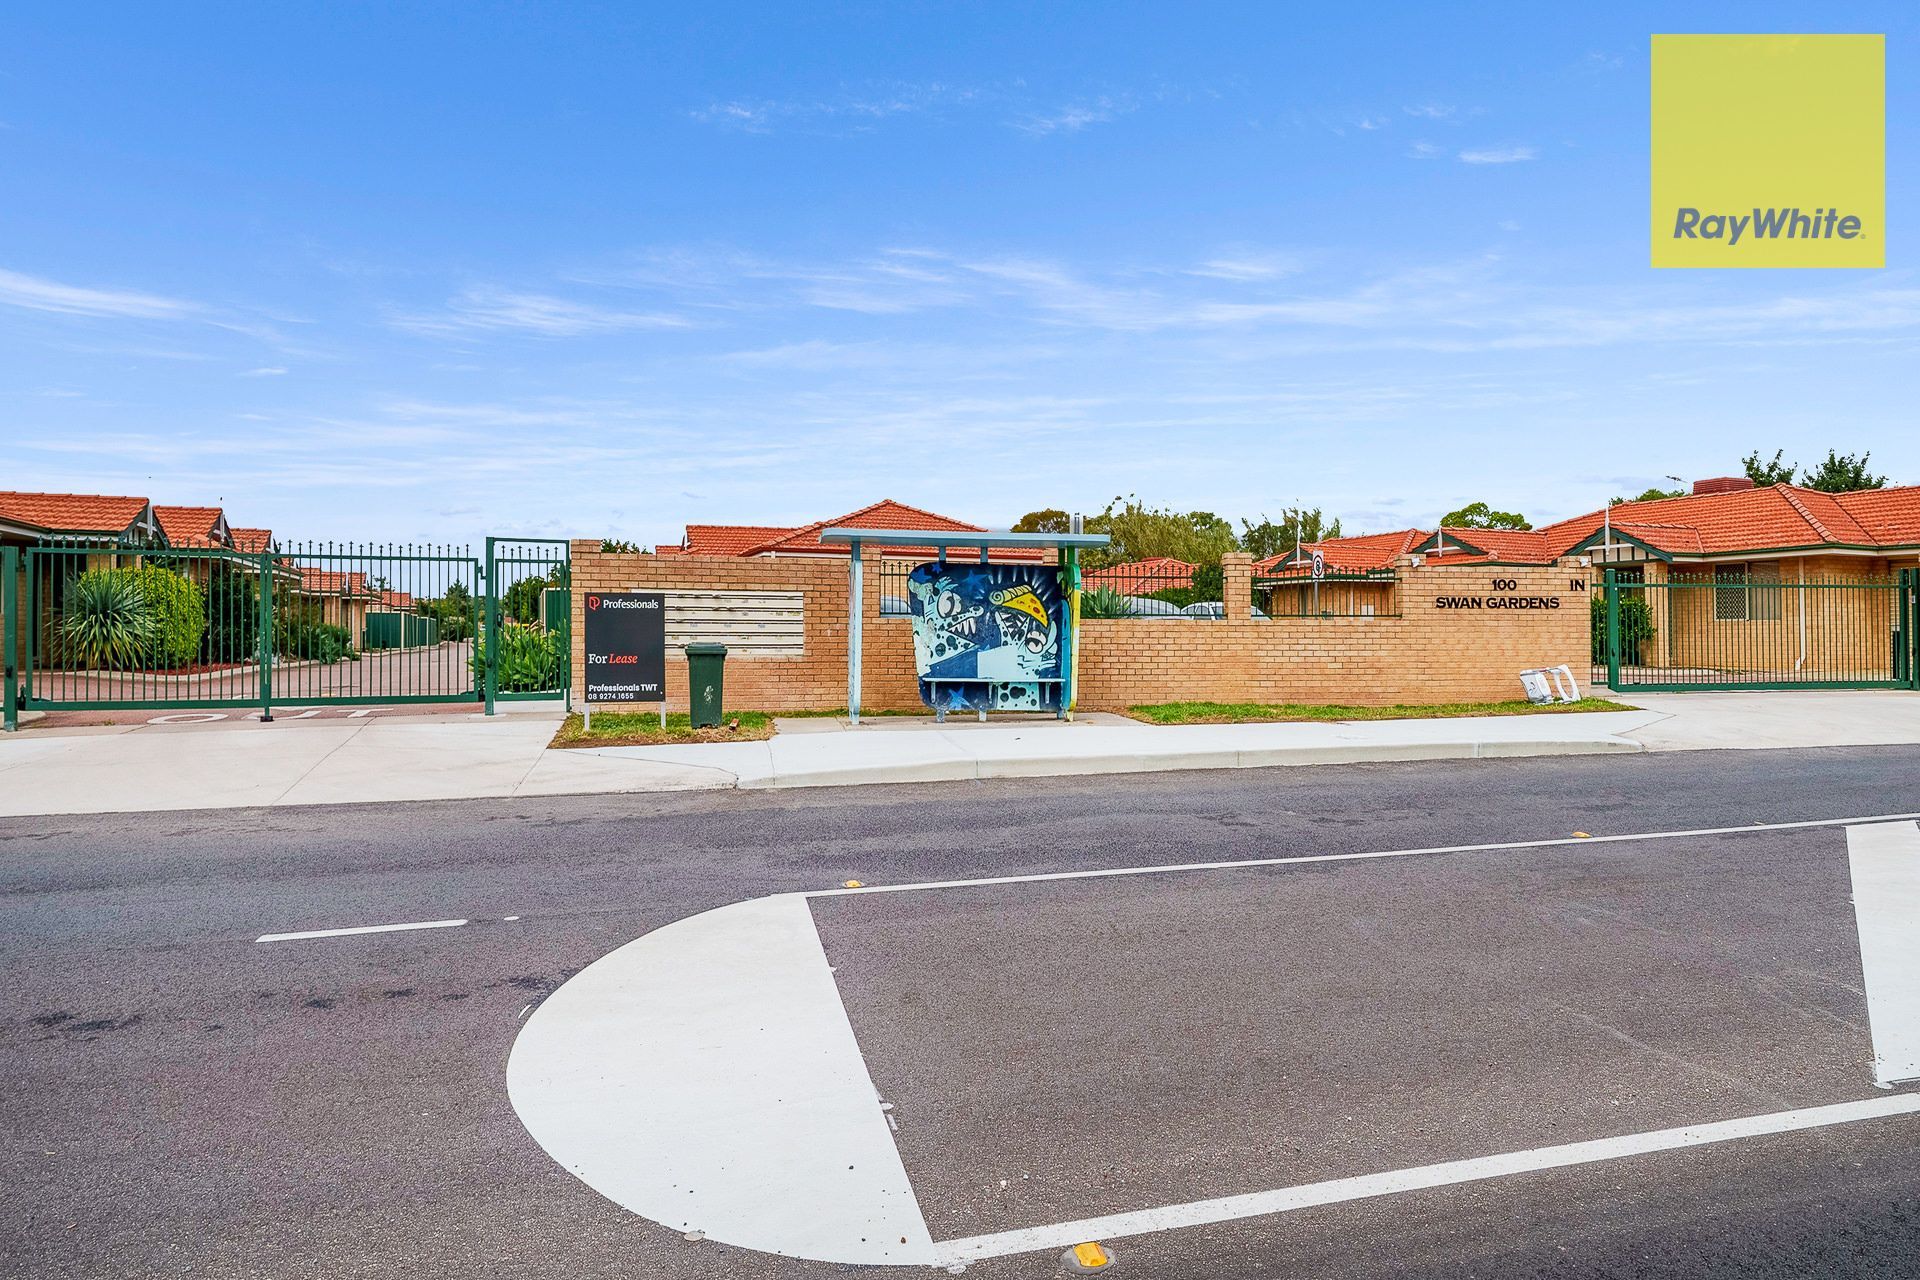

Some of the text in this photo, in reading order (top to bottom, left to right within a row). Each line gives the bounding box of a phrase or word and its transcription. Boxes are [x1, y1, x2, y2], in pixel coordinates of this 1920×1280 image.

[1492, 579, 1517, 591] 100
[1570, 579, 1585, 591] IN
[603, 598, 659, 610] Professionals
[1436, 597, 1560, 609] SWAN GARDENS
[588, 653, 638, 664] For Lease
[588, 683, 658, 692] Professionals TWT
